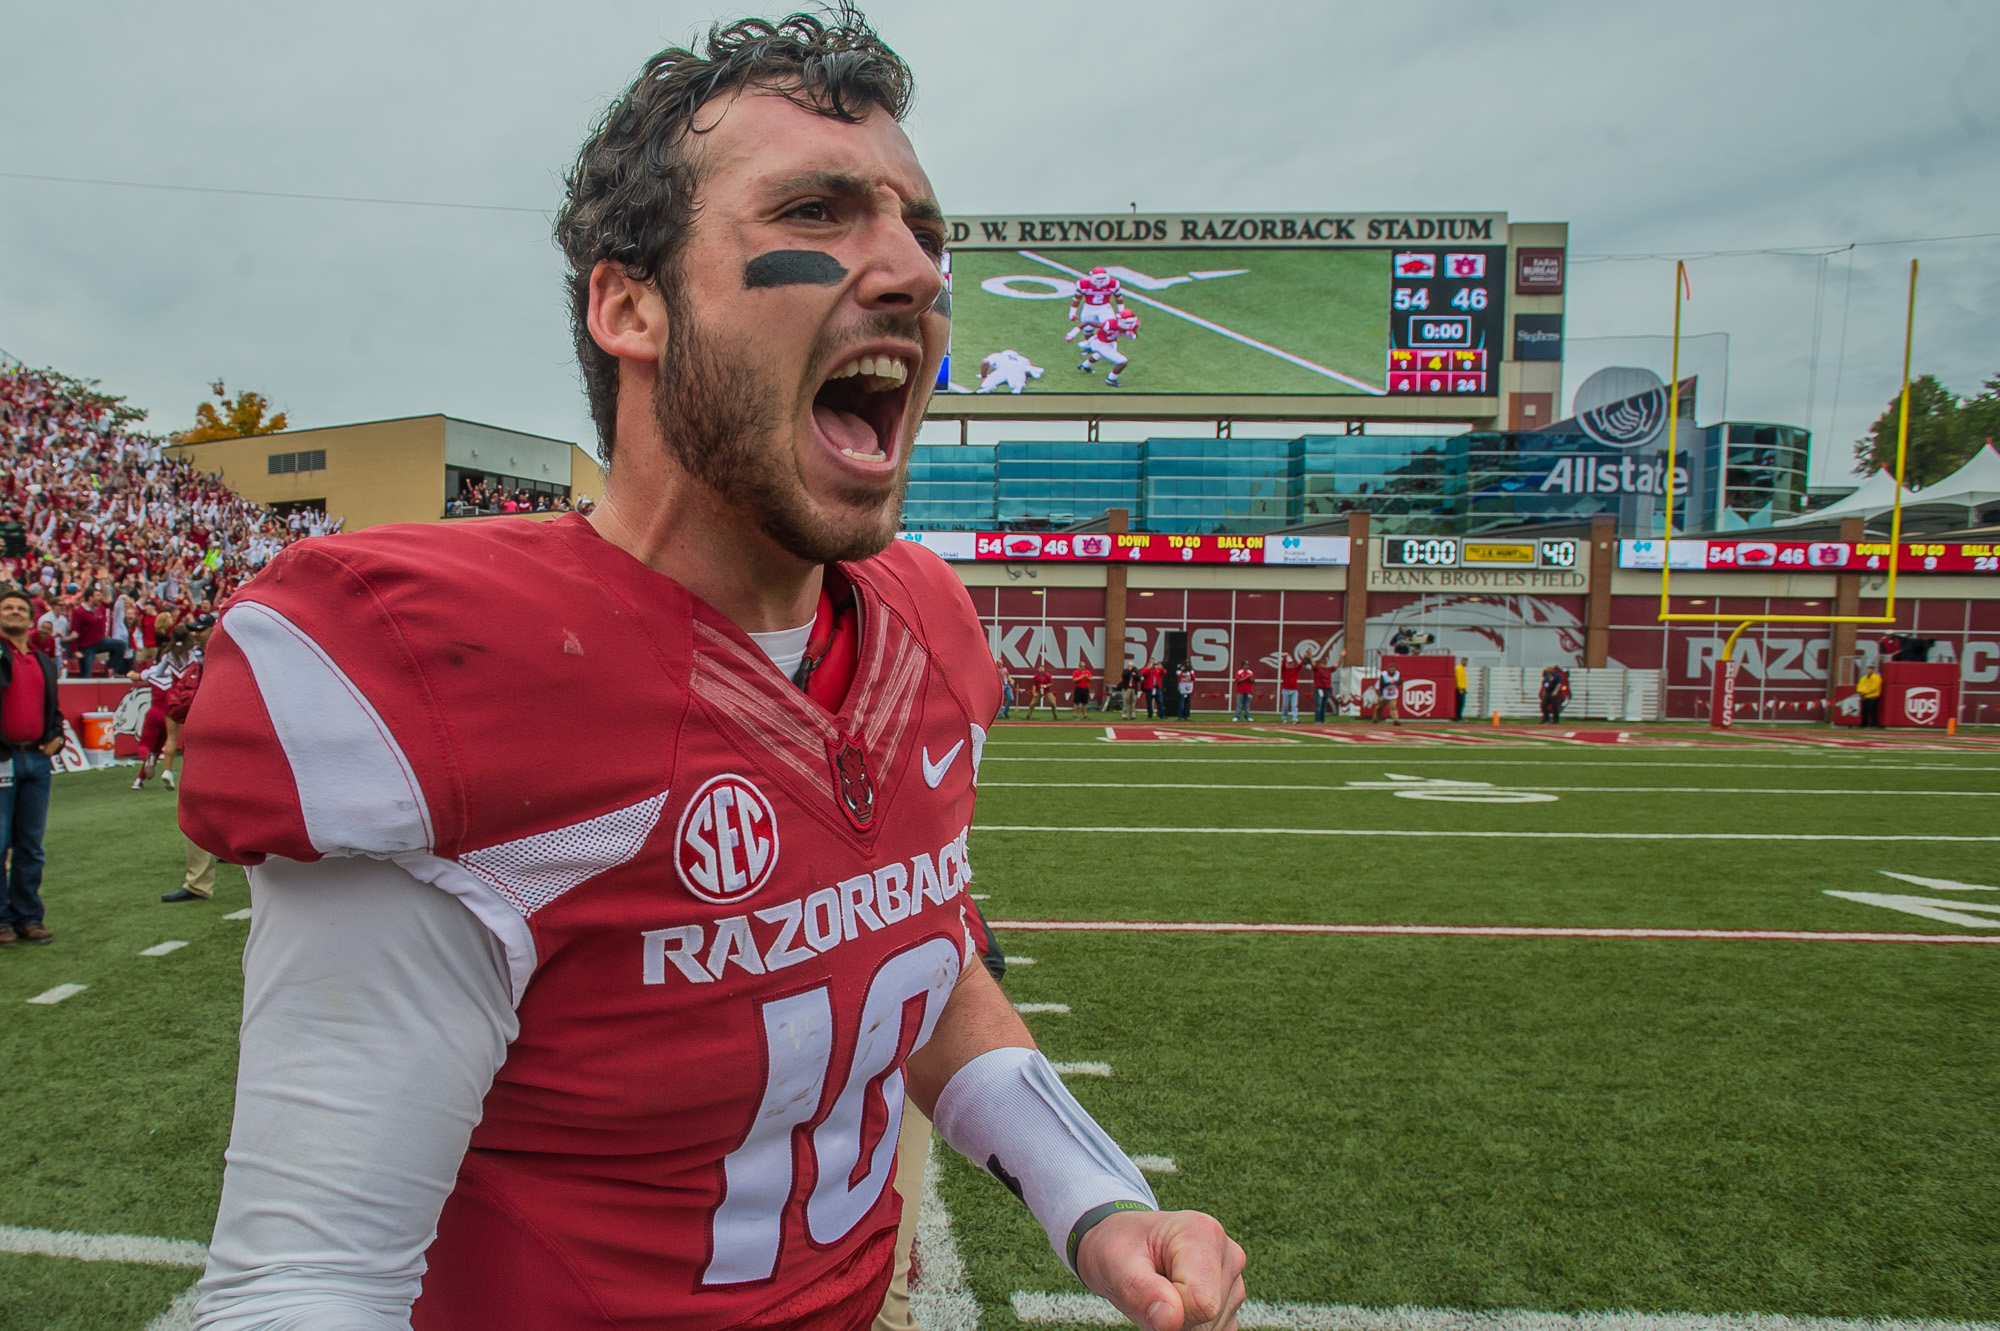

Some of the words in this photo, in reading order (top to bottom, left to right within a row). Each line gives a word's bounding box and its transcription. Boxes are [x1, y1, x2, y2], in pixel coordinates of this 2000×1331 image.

[980, 221, 1008, 242] W.
[1018, 219, 1167, 242] REYNOLDS
[1180, 218, 1356, 241] RAZORBACK
[1367, 218, 1493, 240] STADIUM
[1393, 287, 1430, 311] 54
[1451, 287, 1488, 311] 46
[1421, 323, 1464, 340] 0:00
[1428, 356, 1442, 371] 4
[1457, 379, 1477, 392] 24
[1539, 456, 1689, 496] Allstate
[977, 538, 1002, 554] 54
[1044, 539, 1068, 555] 46
[1117, 535, 1150, 547] DOWN
[1168, 536, 1184, 548] TO
[1185, 536, 1201, 548] GO
[1217, 537, 1245, 549] BALL
[1246, 537, 1263, 549] ON
[1129, 547, 1141, 560] 4
[1181, 548, 1193, 561] 9
[1229, 548, 1251, 562] 24
[1402, 540, 1456, 565] 0:00
[1542, 541, 1574, 566] 40
[1709, 546, 1735, 563] 54
[1778, 548, 1804, 564] 46
[1856, 543, 1891, 556] DOWN
[1909, 544, 1927, 557] TO
[1927, 544, 1946, 557] GO
[1961, 545, 1992, 557] BALL
[1866, 555, 1880, 569] 4
[1924, 556, 1938, 569] 9
[1973, 557, 1999, 570] 24
[1371, 570, 1439, 585] FRANK
[1440, 571, 1527, 586] BROYLES
[1531, 572, 1586, 588] FIELD
[1406, 690, 1433, 711] ups
[1722, 661, 1736, 726] HOGS
[1906, 697, 1937, 719] ups
[685, 785, 771, 894] SEC
[696, 932, 964, 1291] 10
